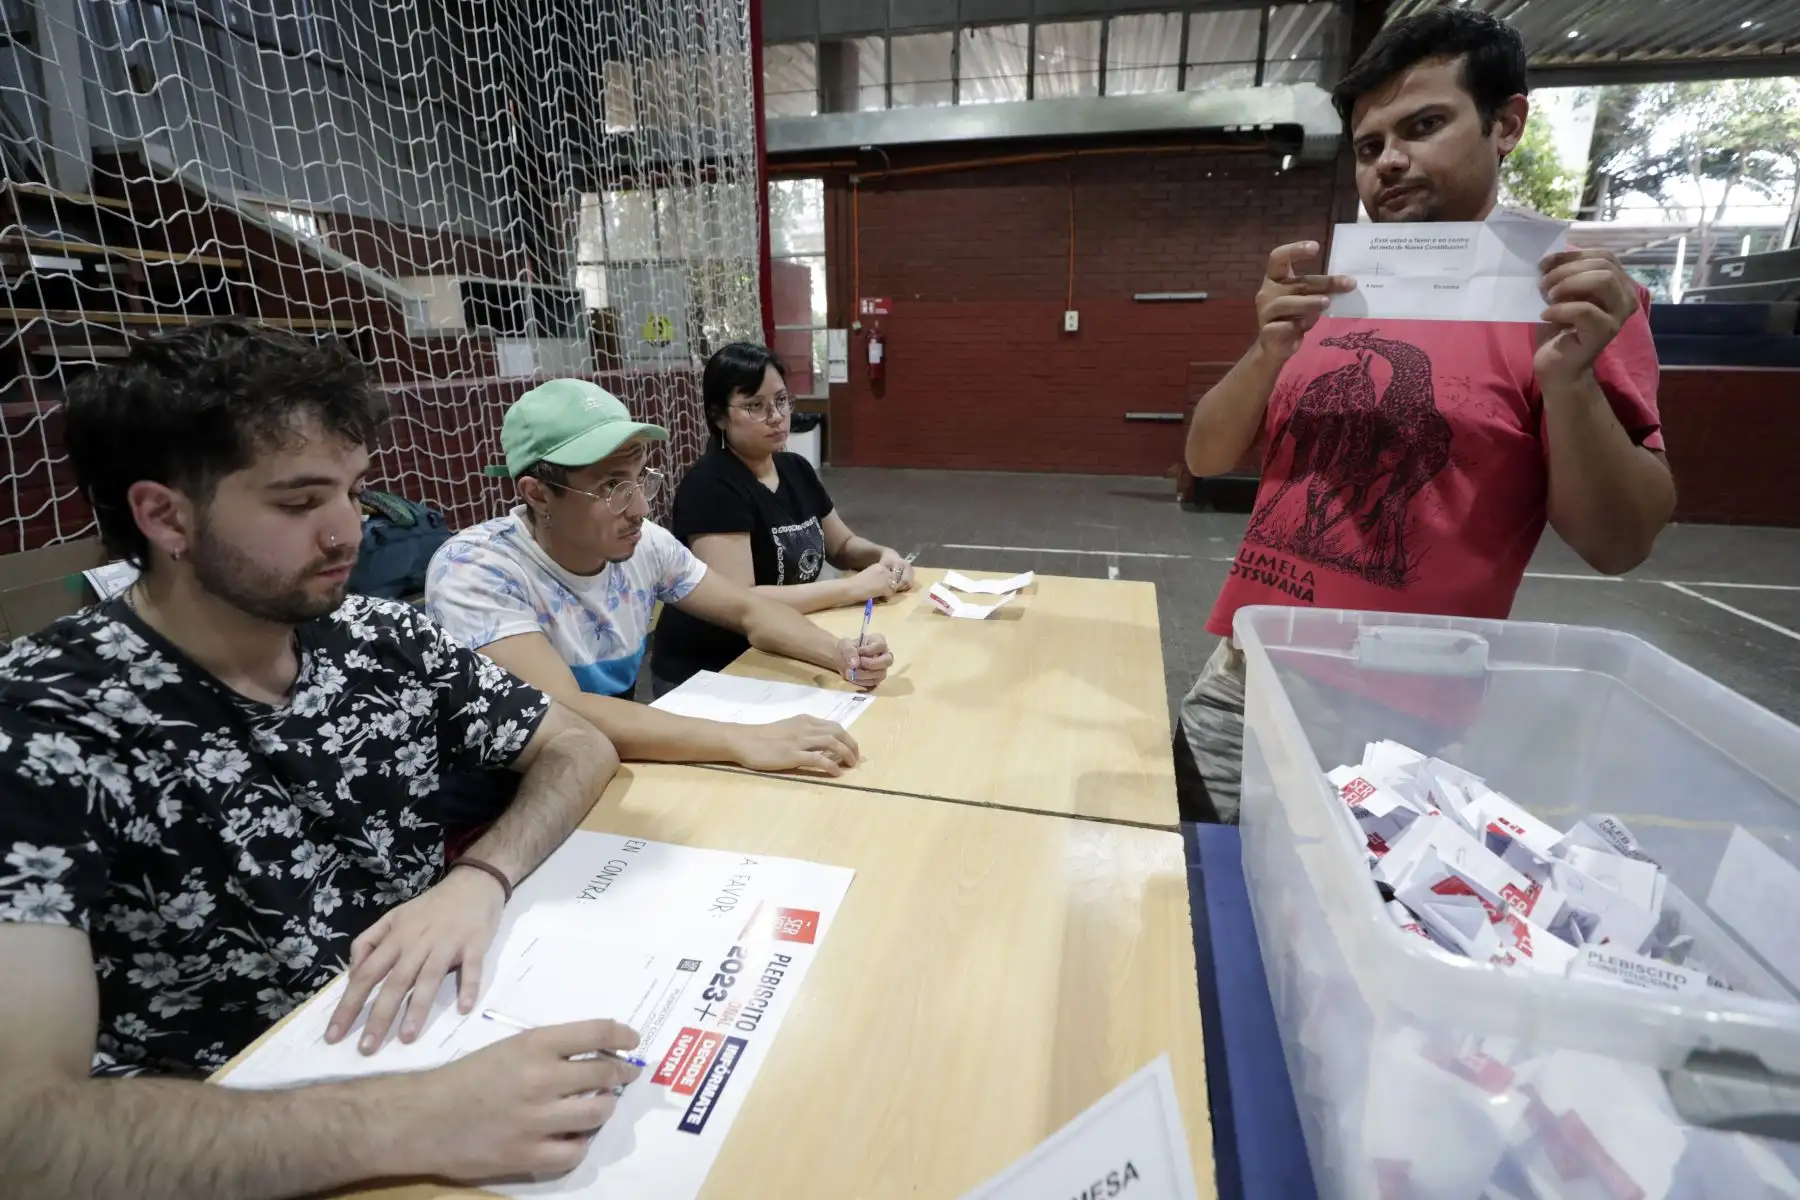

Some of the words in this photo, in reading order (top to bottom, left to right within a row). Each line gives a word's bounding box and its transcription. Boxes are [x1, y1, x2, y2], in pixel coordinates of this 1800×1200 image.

[621, 839, 647, 853] EN
[739, 857, 758, 866] A
[702, 945, 747, 1002] 2023
[1588, 950, 1687, 984] PLEBISCITO
[735, 952, 793, 1032] PLEBISCITO
[680, 1039, 716, 1087] DECIDE
[686, 1043, 741, 1126] INFÓRMATE
